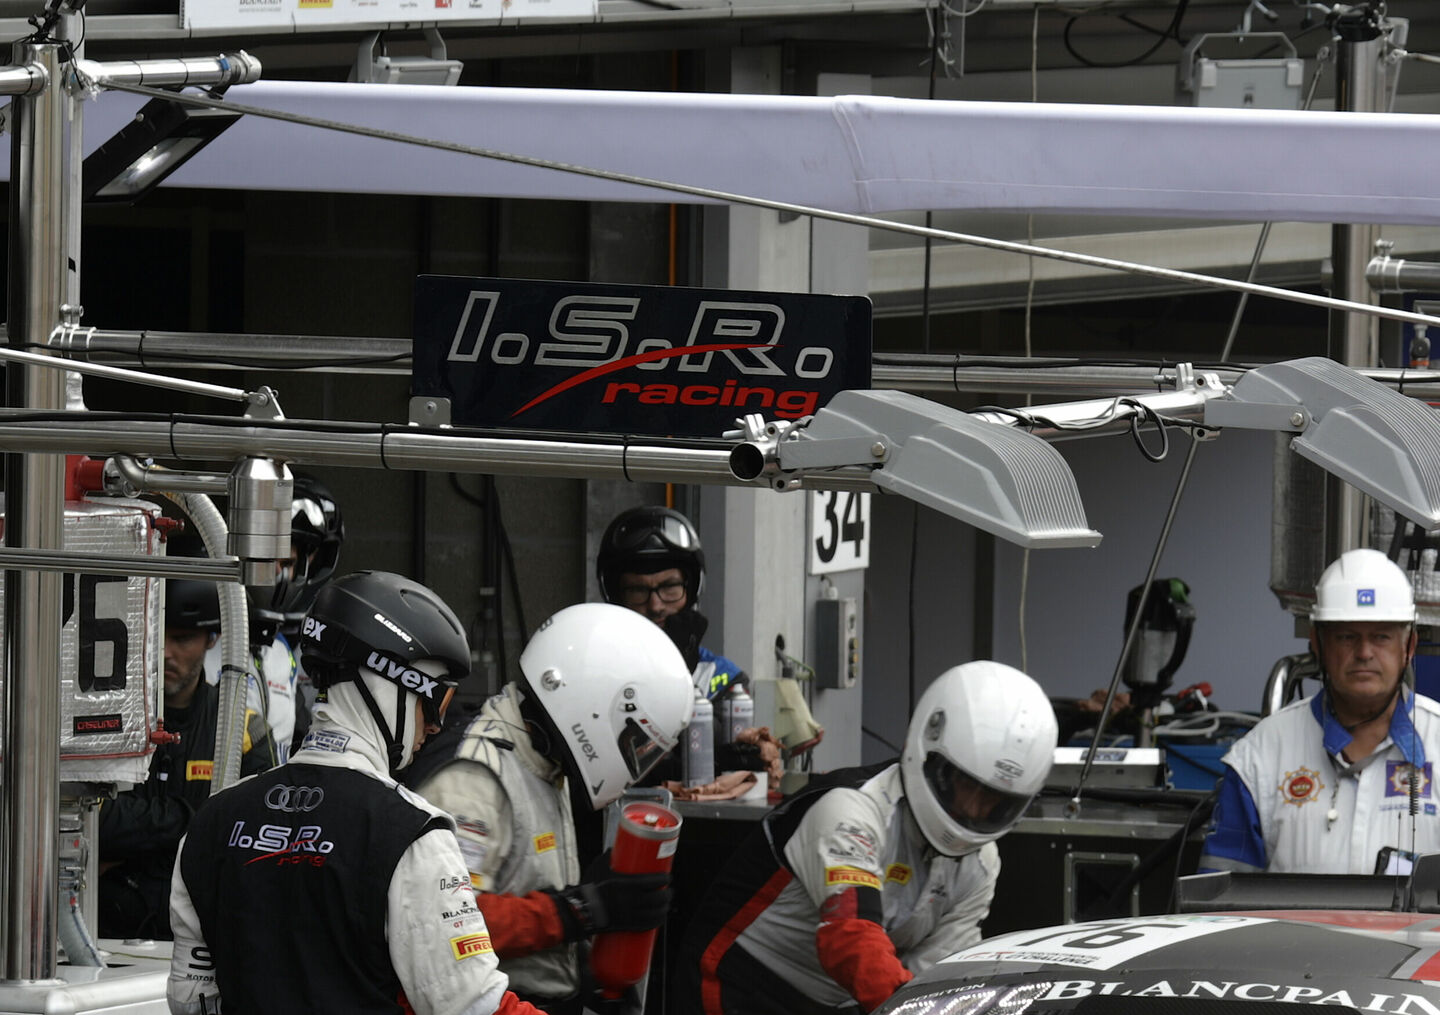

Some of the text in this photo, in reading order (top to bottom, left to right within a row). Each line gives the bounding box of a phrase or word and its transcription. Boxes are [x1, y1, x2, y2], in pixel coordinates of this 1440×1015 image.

[602, 379, 818, 419] racing
[816, 490, 865, 563] 34
[366, 651, 439, 699] uvex
[571, 722, 599, 763] uvex
